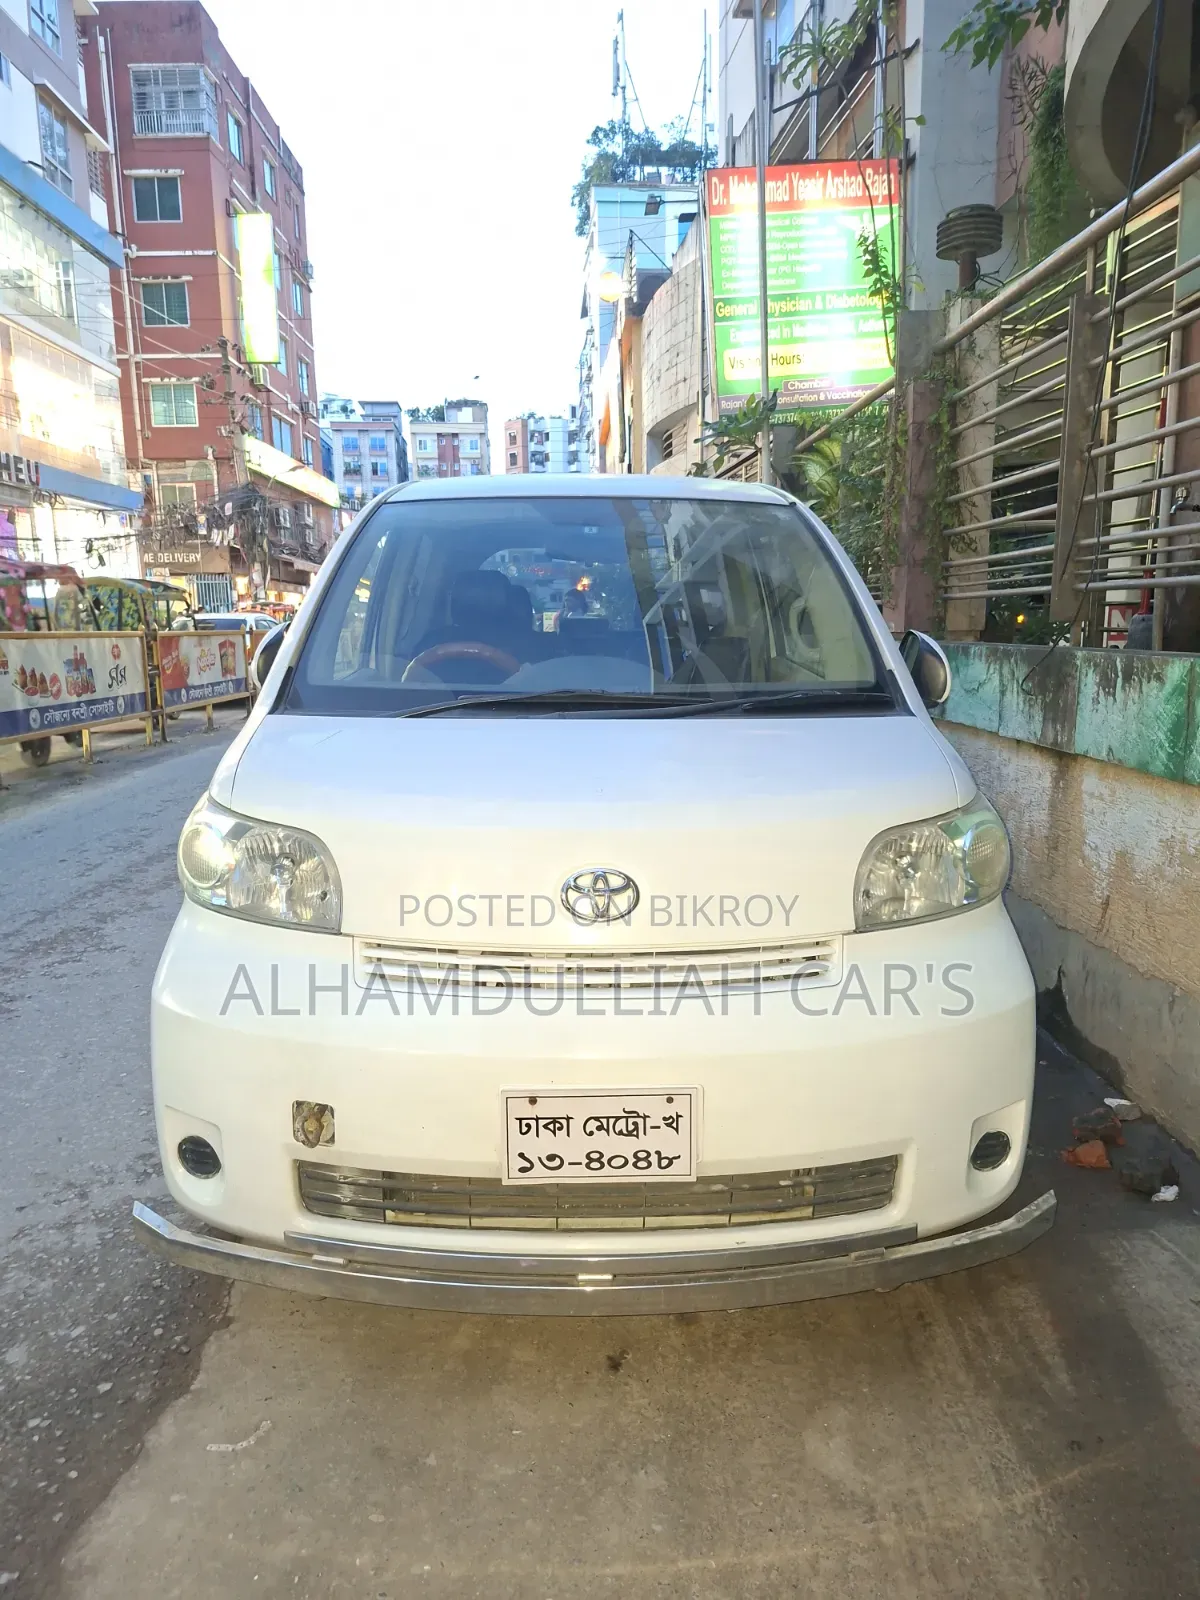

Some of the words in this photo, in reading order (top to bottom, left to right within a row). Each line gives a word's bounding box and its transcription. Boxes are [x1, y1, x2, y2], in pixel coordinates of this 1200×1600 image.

[711, 176, 727, 206] Dr.
[729, 172, 790, 205] Mohamad
[825, 168, 863, 199] Arshad
[865, 166, 895, 203] Rajan
[715, 301, 758, 317] General
[767, 296, 813, 317] hysician
[777, 392, 818, 405] onsultation
[826, 388, 871, 400] Vaccinatio
[157, 552, 201, 563] DELIVERY
[515, 1114, 574, 1138] ঢাকা
[517, 1149, 681, 1174] ১৩-৪০৪৮
